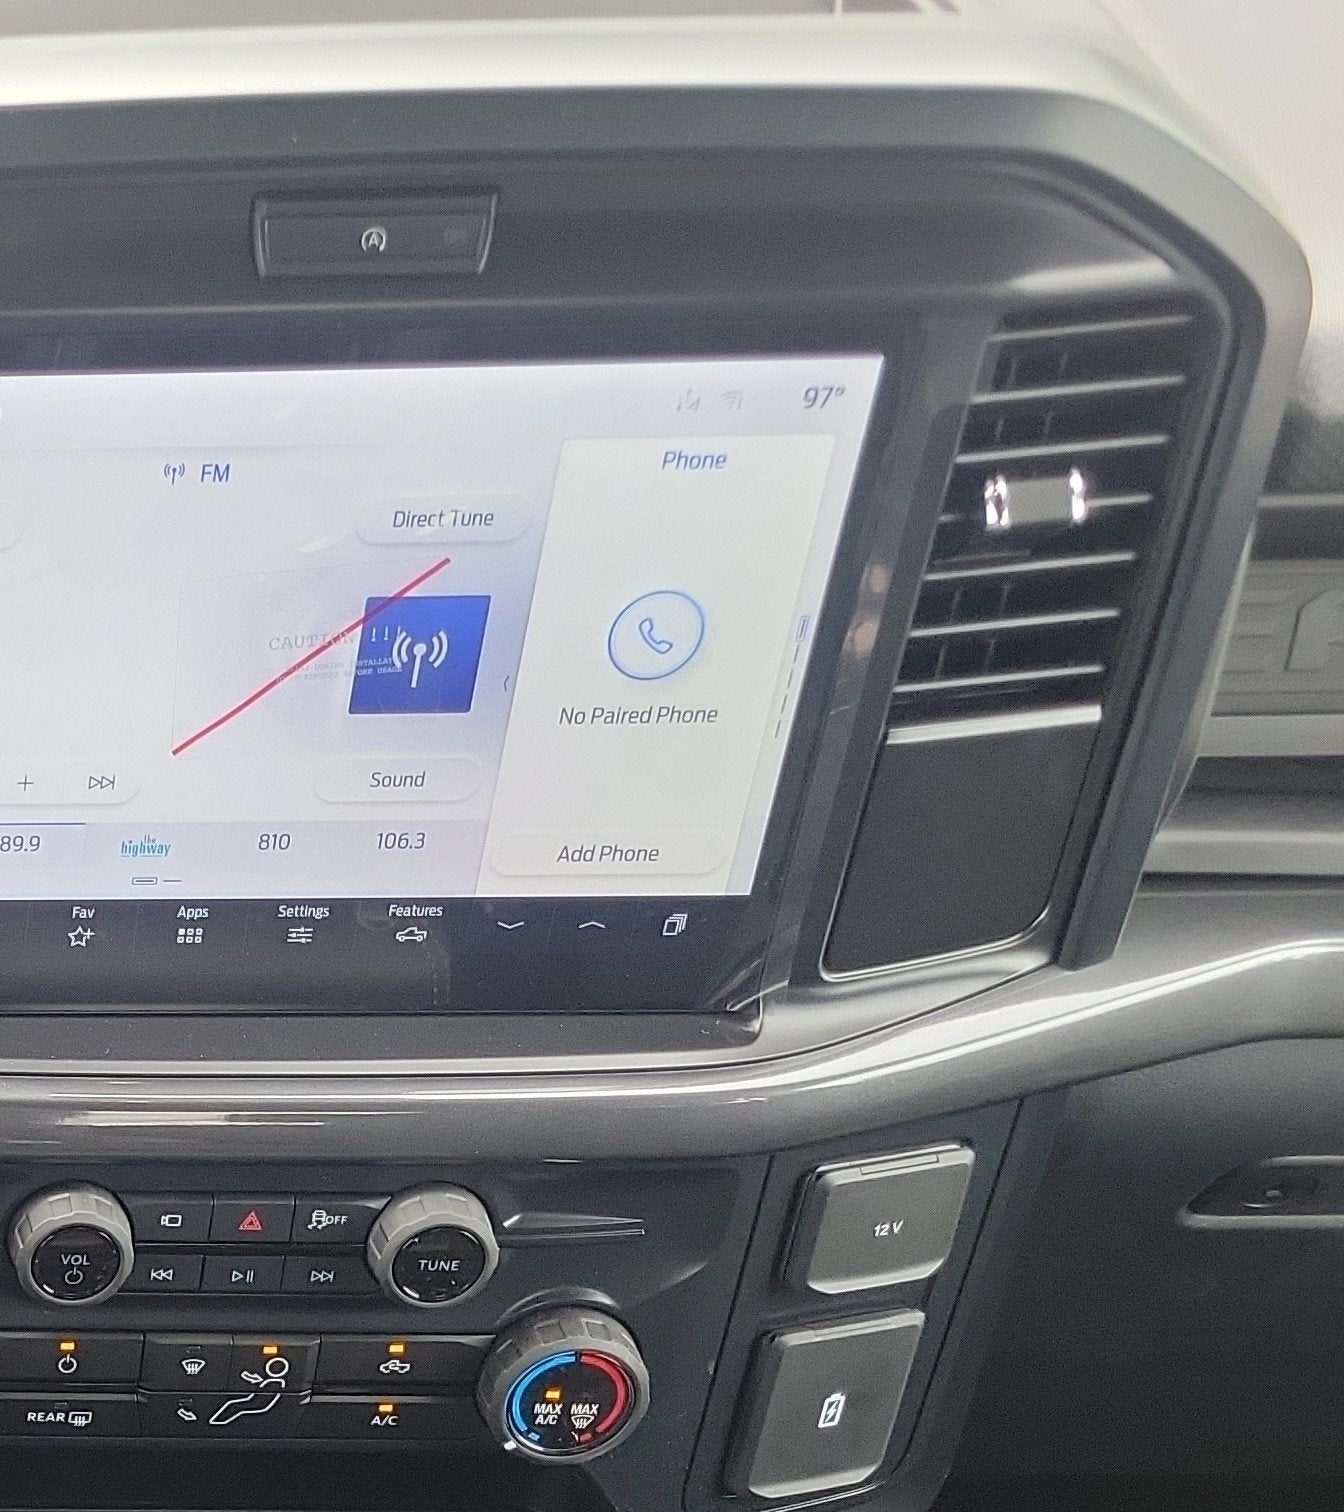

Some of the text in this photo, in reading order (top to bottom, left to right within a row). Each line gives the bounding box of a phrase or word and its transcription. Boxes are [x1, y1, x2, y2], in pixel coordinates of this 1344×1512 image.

[662, 450, 728, 471] Phone
[199, 463, 231, 484] FM
[392, 508, 495, 530] Direct Tune
[559, 704, 719, 726] No Paired Phone
[369, 769, 427, 789] Sound
[0, 834, 42, 854] 89.9
[120, 840, 171, 857] highway
[258, 833, 291, 851] 810
[376, 831, 427, 851] 106.3
[555, 844, 660, 863] Add Phone
[71, 906, 96, 920] Fav
[176, 905, 210, 923] Apps
[277, 903, 331, 921] Settings
[388, 903, 444, 918] Features
[325, 1214, 349, 1225] OFF
[60, 1253, 92, 1267] VOL
[418, 1259, 461, 1272] TUNE
[26, 1410, 67, 1424] REAR
[533, 1402, 564, 1416] MAX
[570, 1402, 600, 1416] MAX
[370, 1414, 400, 1427] A/C
[534, 1414, 560, 1426] A/C
